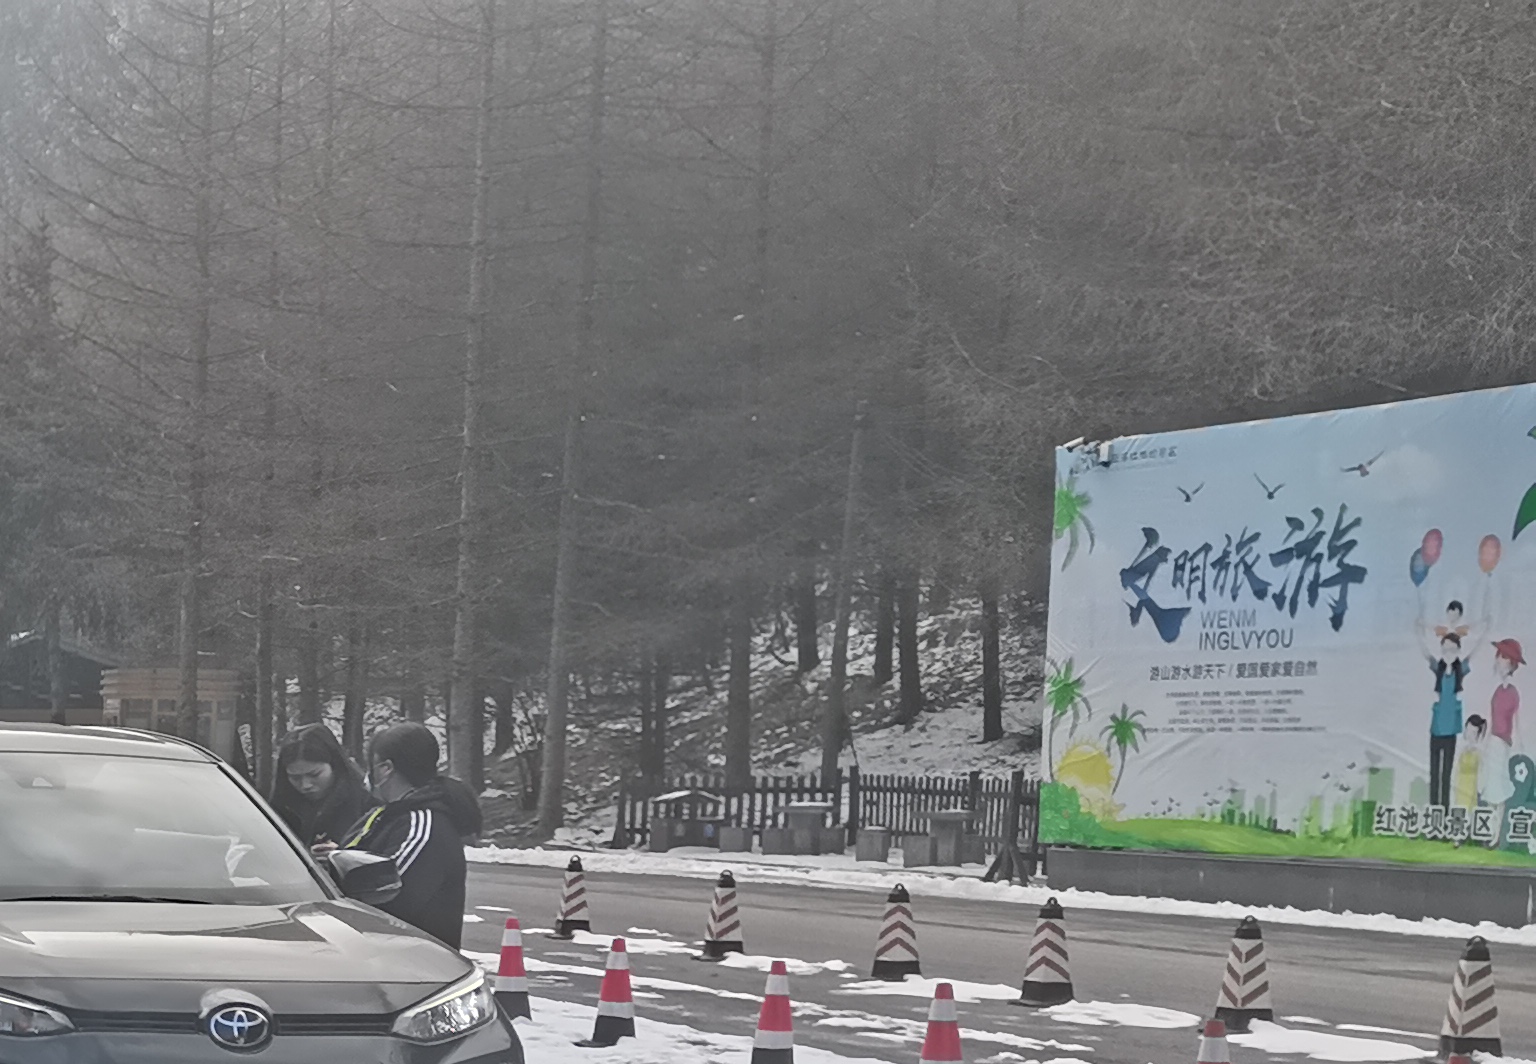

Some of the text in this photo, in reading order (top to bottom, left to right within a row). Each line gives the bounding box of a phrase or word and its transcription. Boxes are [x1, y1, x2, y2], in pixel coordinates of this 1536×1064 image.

[1119, 502, 1369, 644] 文明旅游
[1200, 609, 1257, 629] WENM
[1198, 629, 1295, 652] INGLVYOU
[1374, 804, 1494, 839] 红池坝景区
